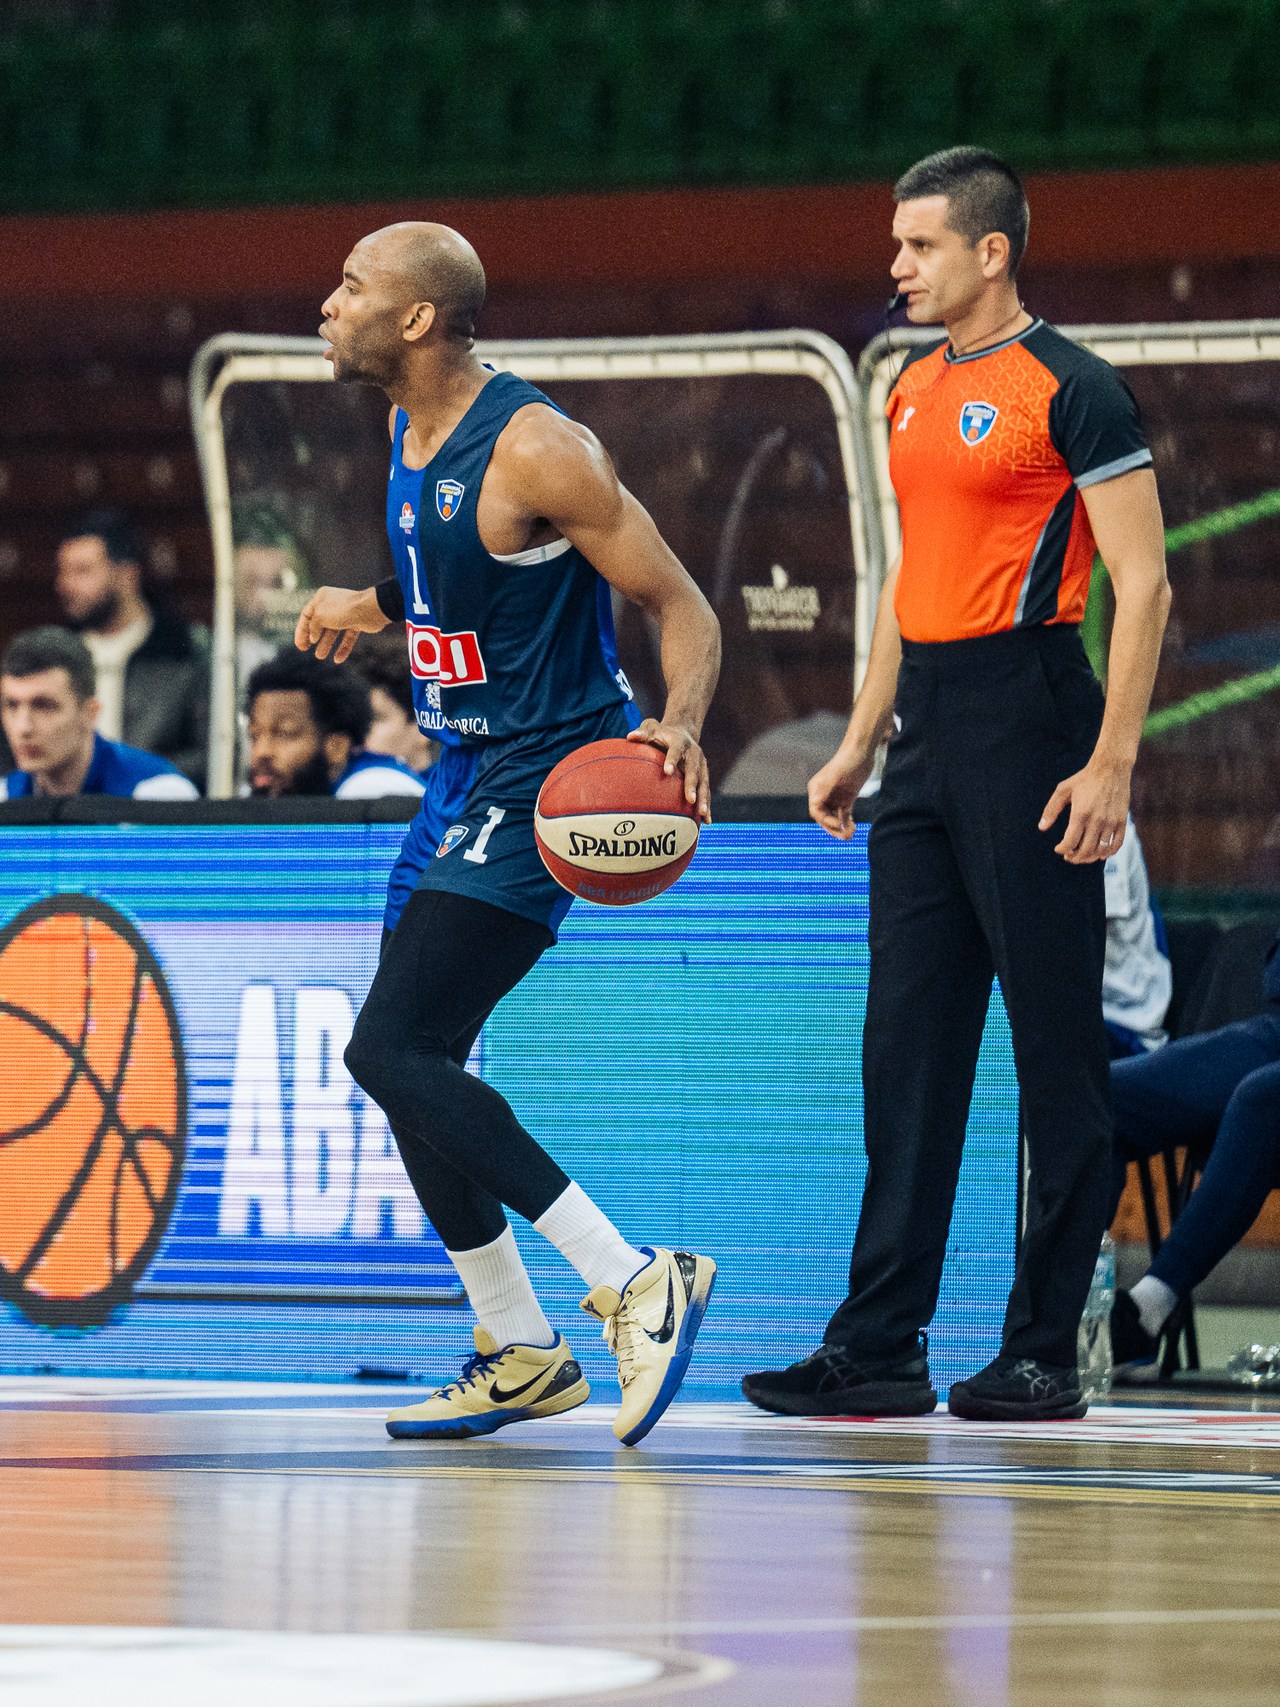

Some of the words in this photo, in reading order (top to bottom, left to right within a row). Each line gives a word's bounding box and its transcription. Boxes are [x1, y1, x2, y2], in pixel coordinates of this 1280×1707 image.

[406, 545, 430, 615] 1
[463, 806, 506, 864] 1
[568, 829, 677, 857] SPALDING
